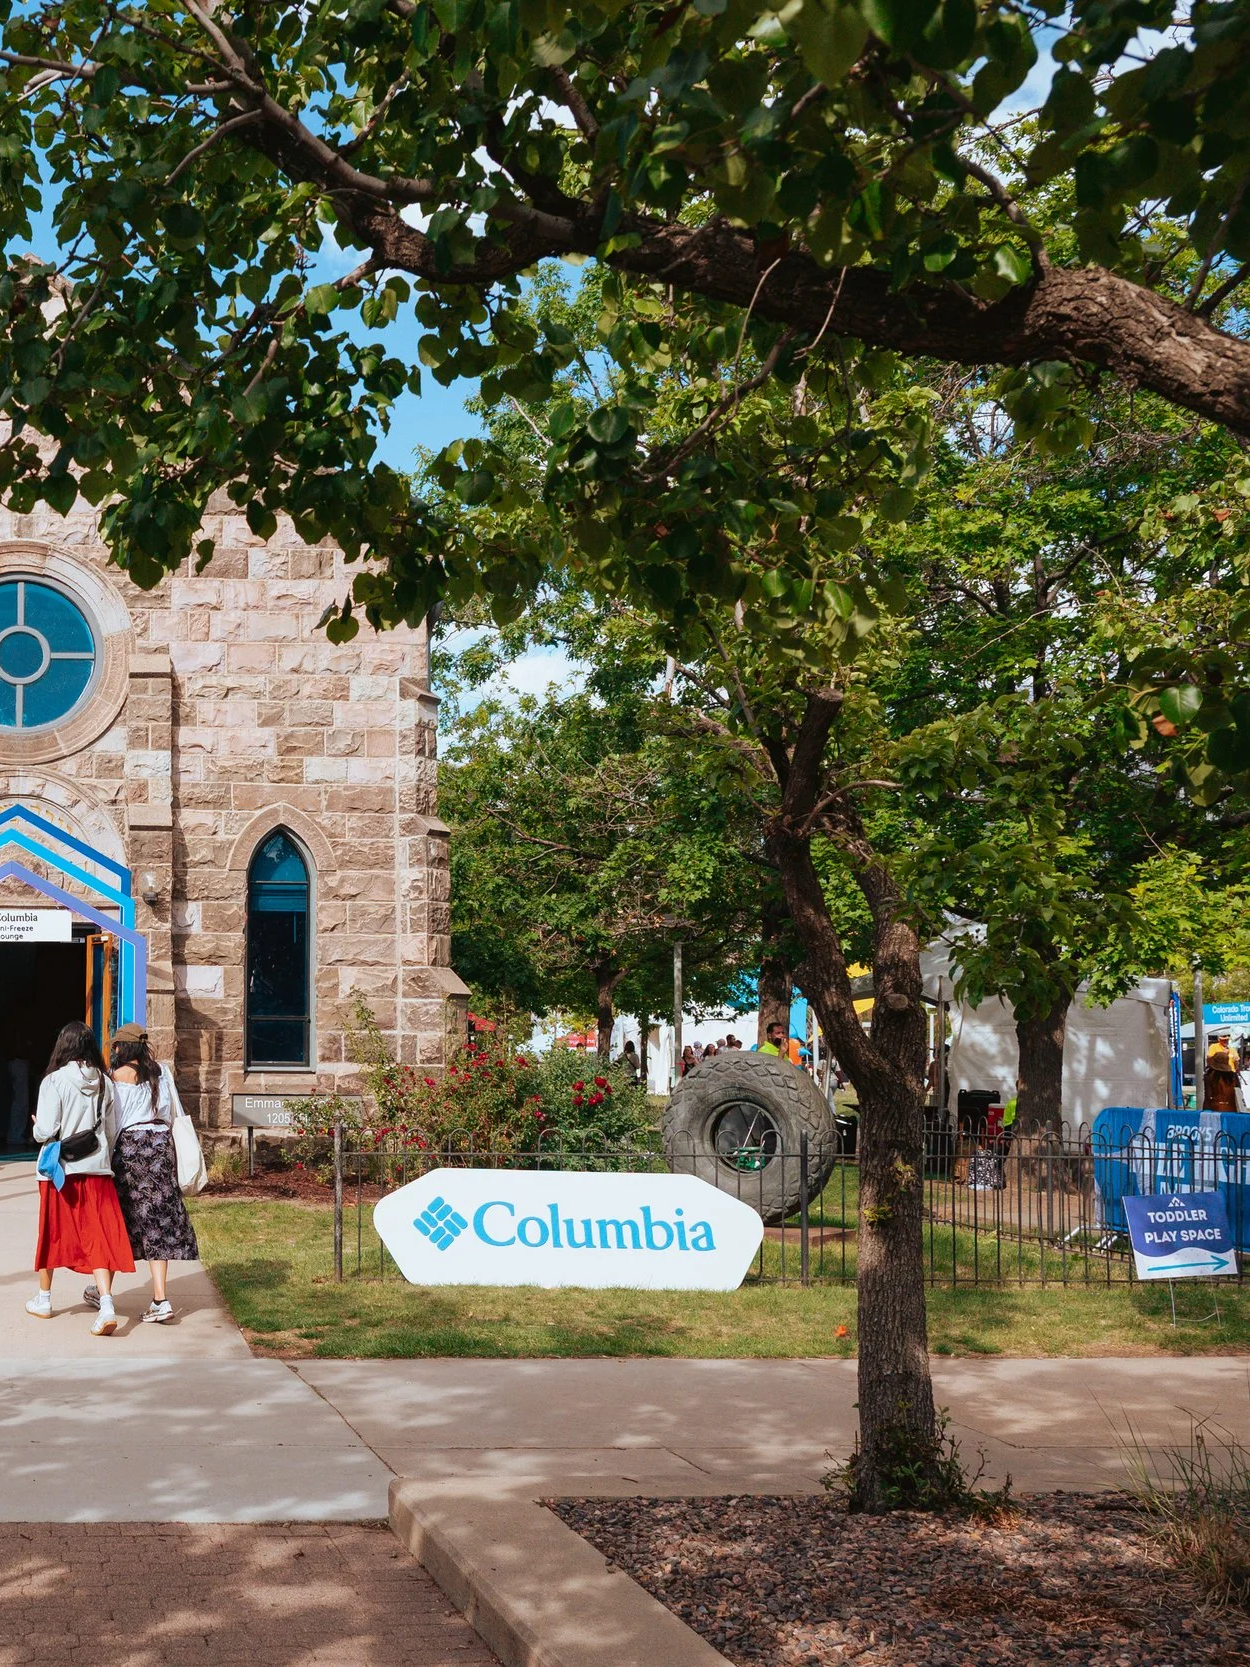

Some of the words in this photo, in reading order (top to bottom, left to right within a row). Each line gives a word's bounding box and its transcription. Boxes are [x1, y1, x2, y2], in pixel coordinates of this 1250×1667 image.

[1212, 1004, 1239, 1014] Colorado
[1220, 1013, 1249, 1022] Unlimited
[267, 1112, 291, 1124] 1205
[1166, 1124, 1212, 1141] BROOKS
[1147, 1209, 1207, 1223] TODDLER
[473, 1201, 716, 1252] Columbia
[1144, 1230, 1177, 1243] PLAY
[1180, 1228, 1222, 1241] SPACE
